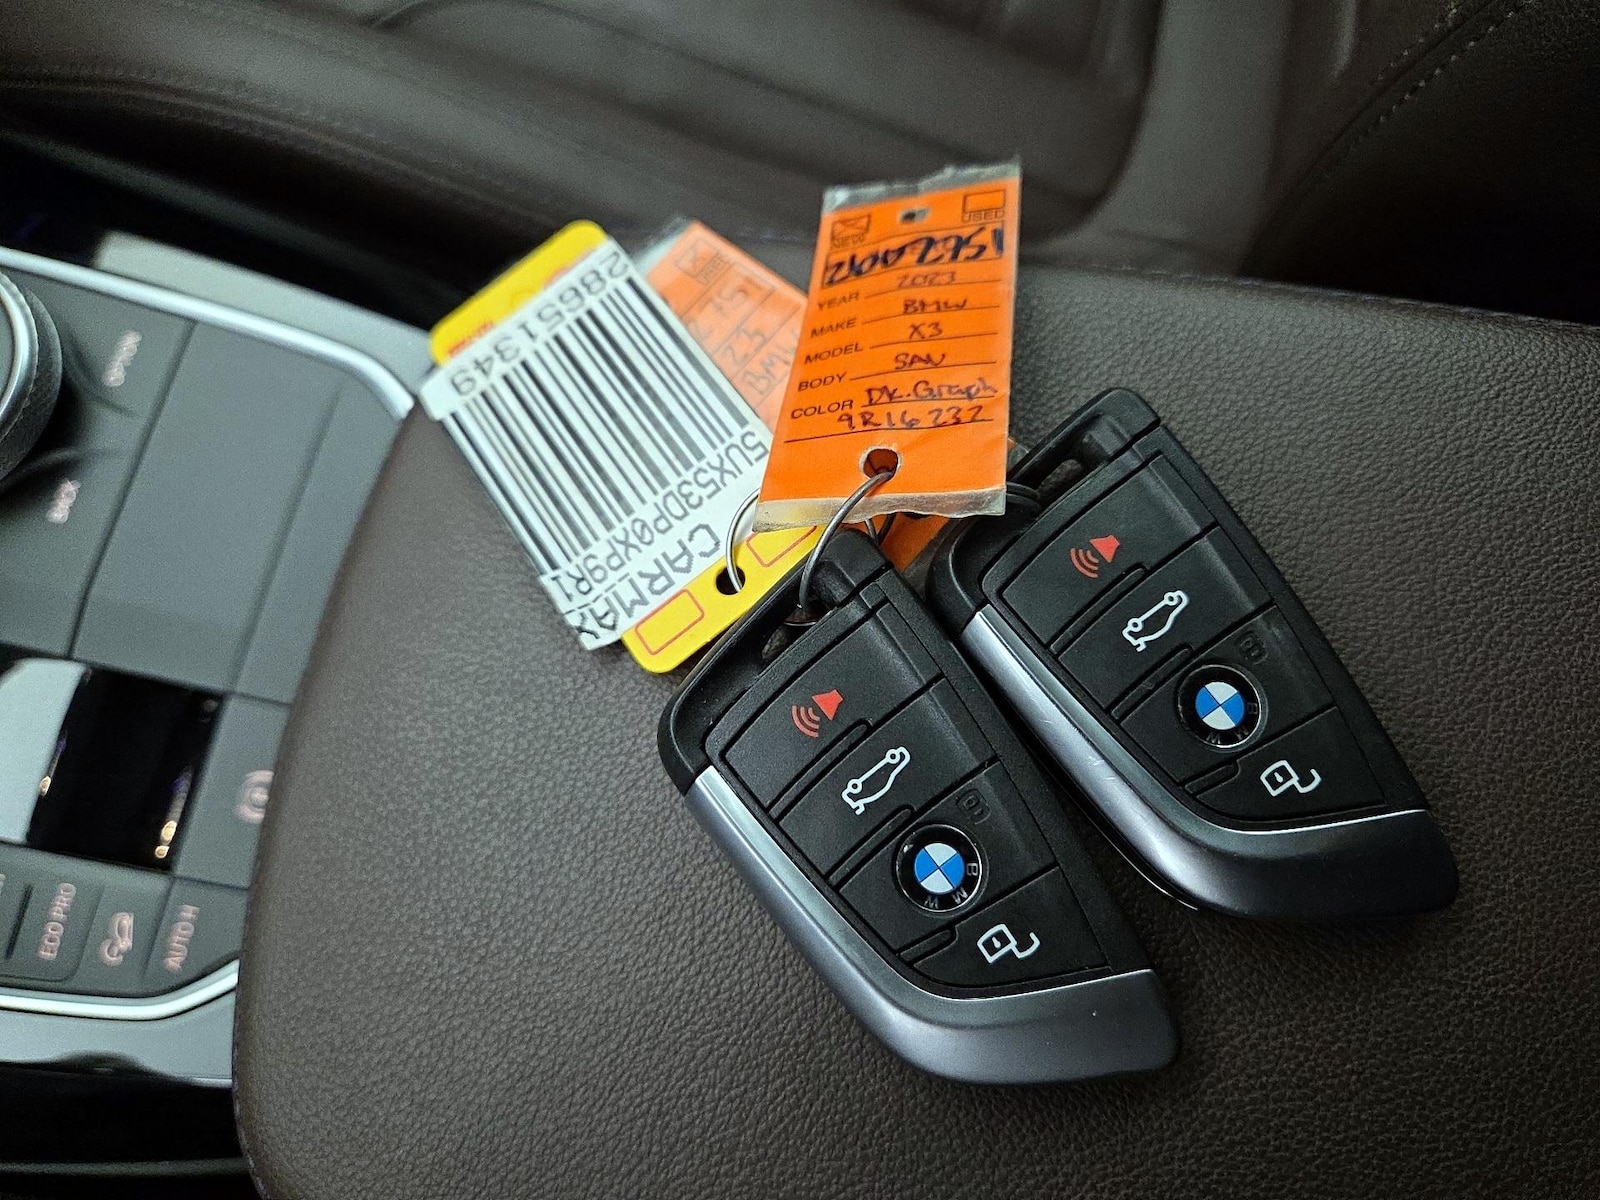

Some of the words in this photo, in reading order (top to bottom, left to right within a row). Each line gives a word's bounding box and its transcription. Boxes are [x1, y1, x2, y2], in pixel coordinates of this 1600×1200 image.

[961, 209, 1005, 223] USED
[810, 318, 857, 338] MAKE
[903, 298, 968, 314] BMW
[816, 291, 860, 312] YEAR
[451, 250, 630, 397] 28651349
[804, 342, 864, 365] MODEL
[909, 322, 944, 340] X3
[797, 373, 847, 392] BODY
[894, 352, 947, 370] SAV
[791, 400, 854, 420] COLOR
[576, 523, 721, 639] CARMAX
[49, 882, 77, 922] PRO
[37, 921, 65, 960] ECO
[163, 921, 195, 972] AUTO
